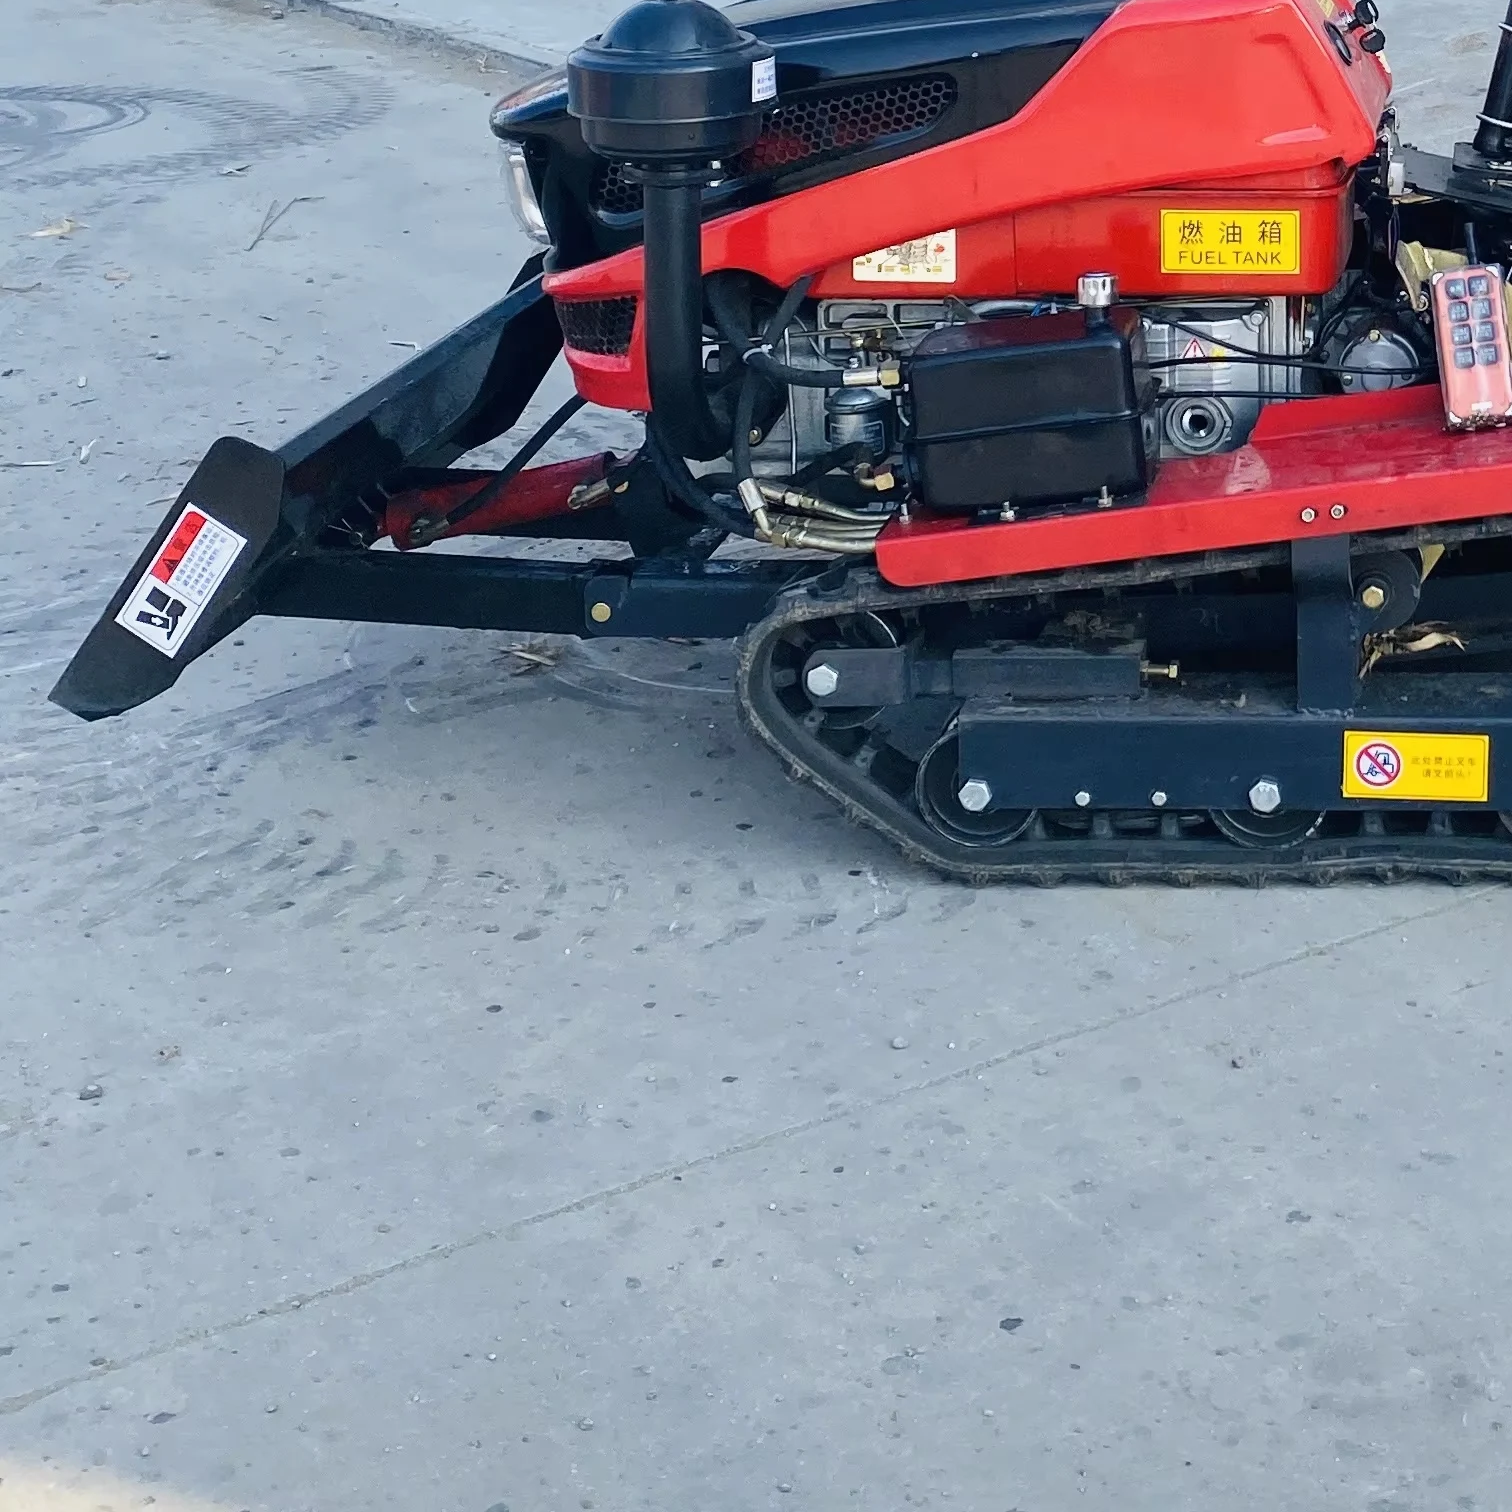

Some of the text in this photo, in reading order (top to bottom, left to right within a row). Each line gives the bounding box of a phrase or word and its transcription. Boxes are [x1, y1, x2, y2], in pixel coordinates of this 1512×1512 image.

[1179, 220, 1282, 245] 燃油箱
[1179, 251, 1281, 264] FUEL TANK
